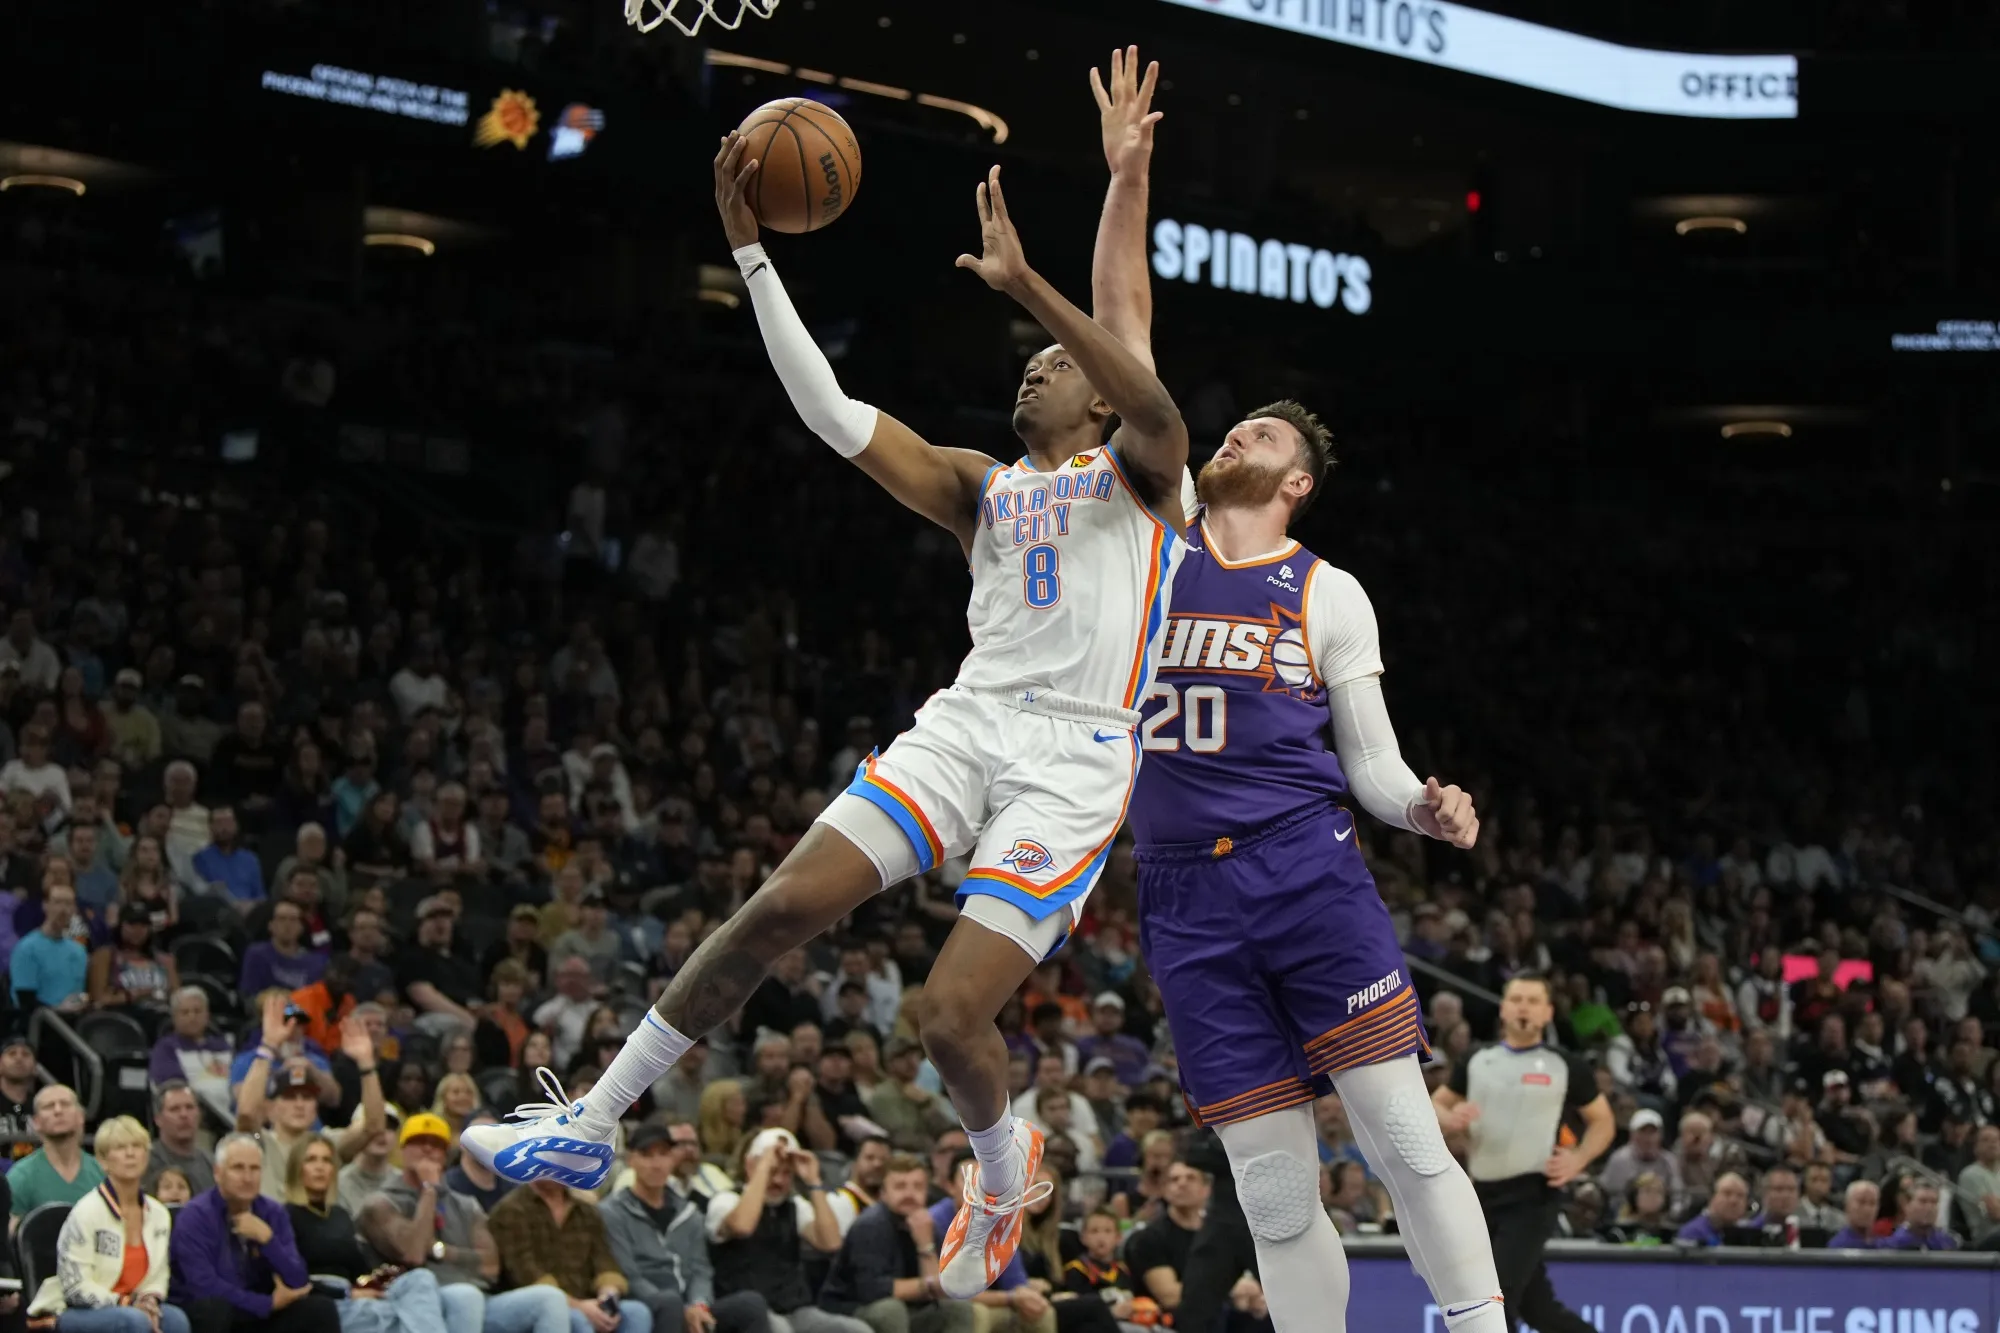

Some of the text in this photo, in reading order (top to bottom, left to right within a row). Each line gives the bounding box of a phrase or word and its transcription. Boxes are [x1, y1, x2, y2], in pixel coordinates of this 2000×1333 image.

[1152, 218, 1372, 315] SPINATO'S
[982, 469, 1116, 530] OKLAOMA
[1013, 502, 1071, 546] CITY
[1023, 542, 1061, 610] 8
[1266, 575, 1299, 593] PayPal
[1158, 619, 1269, 671] UNS
[1142, 682, 1228, 754] 20
[1346, 968, 1402, 1015] PHOENIX
